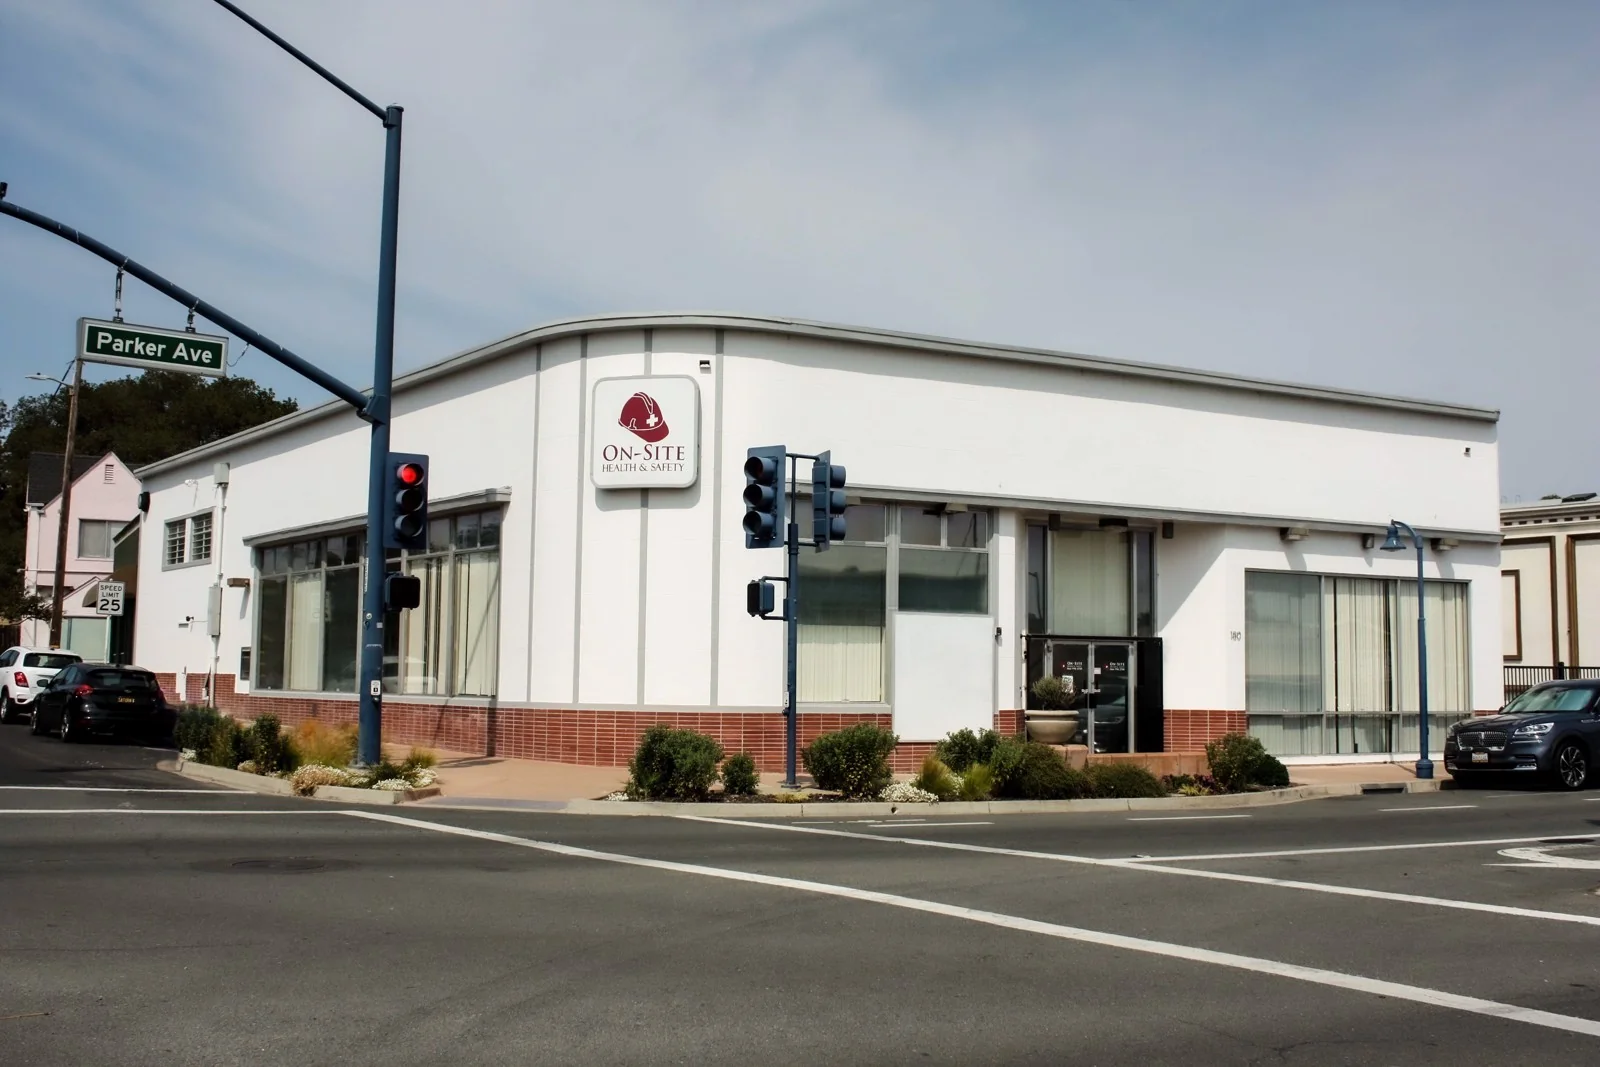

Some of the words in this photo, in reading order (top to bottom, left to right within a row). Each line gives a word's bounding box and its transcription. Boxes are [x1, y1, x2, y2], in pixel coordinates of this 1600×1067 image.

[96, 331, 167, 357] Parker
[172, 342, 213, 364] Ave
[602, 463, 637, 473] HEALTH
[638, 463, 648, 472] &
[650, 462, 685, 472] SAFETY
[100, 584, 122, 592] SPEED
[100, 598, 120, 612] 25
